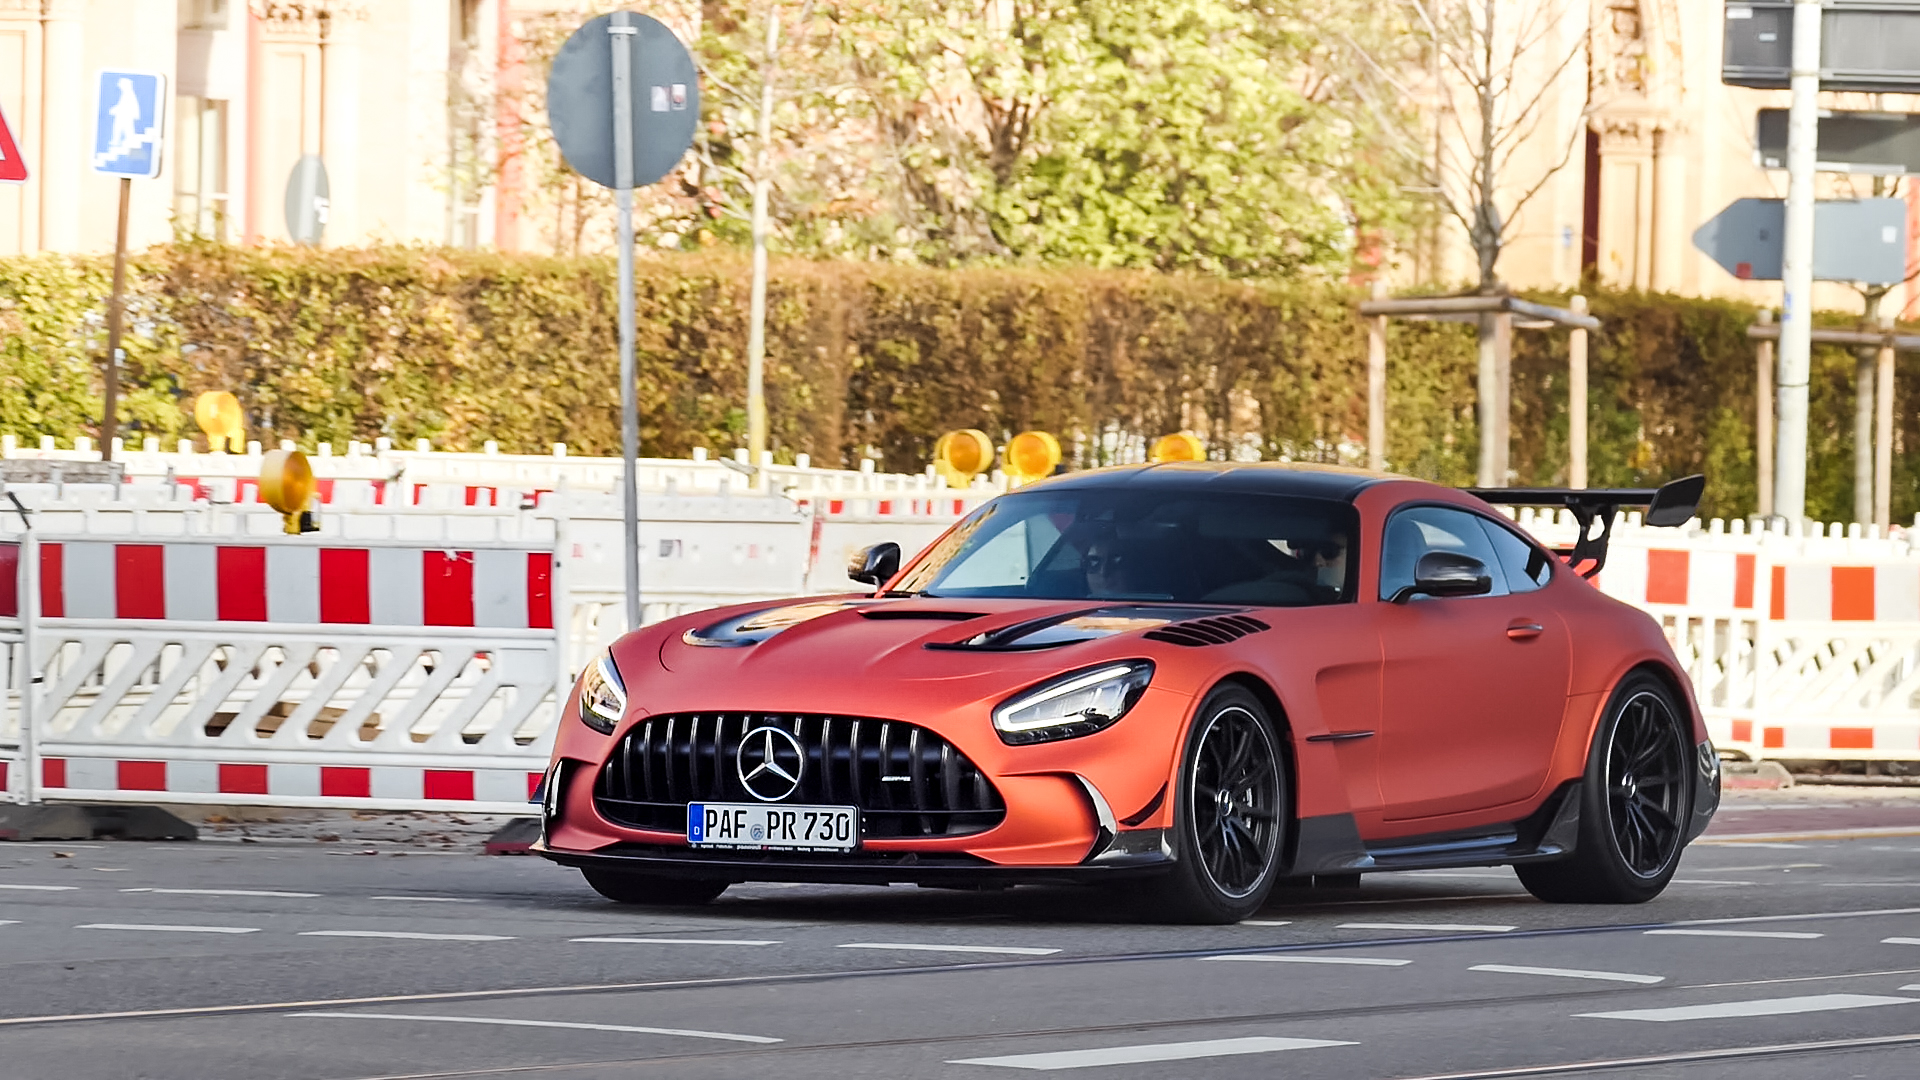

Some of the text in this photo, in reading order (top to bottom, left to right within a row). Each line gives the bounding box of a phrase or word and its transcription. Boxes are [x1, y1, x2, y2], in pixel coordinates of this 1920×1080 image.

[693, 826, 700, 836] D
[705, 809, 850, 841] PAF PR 730
